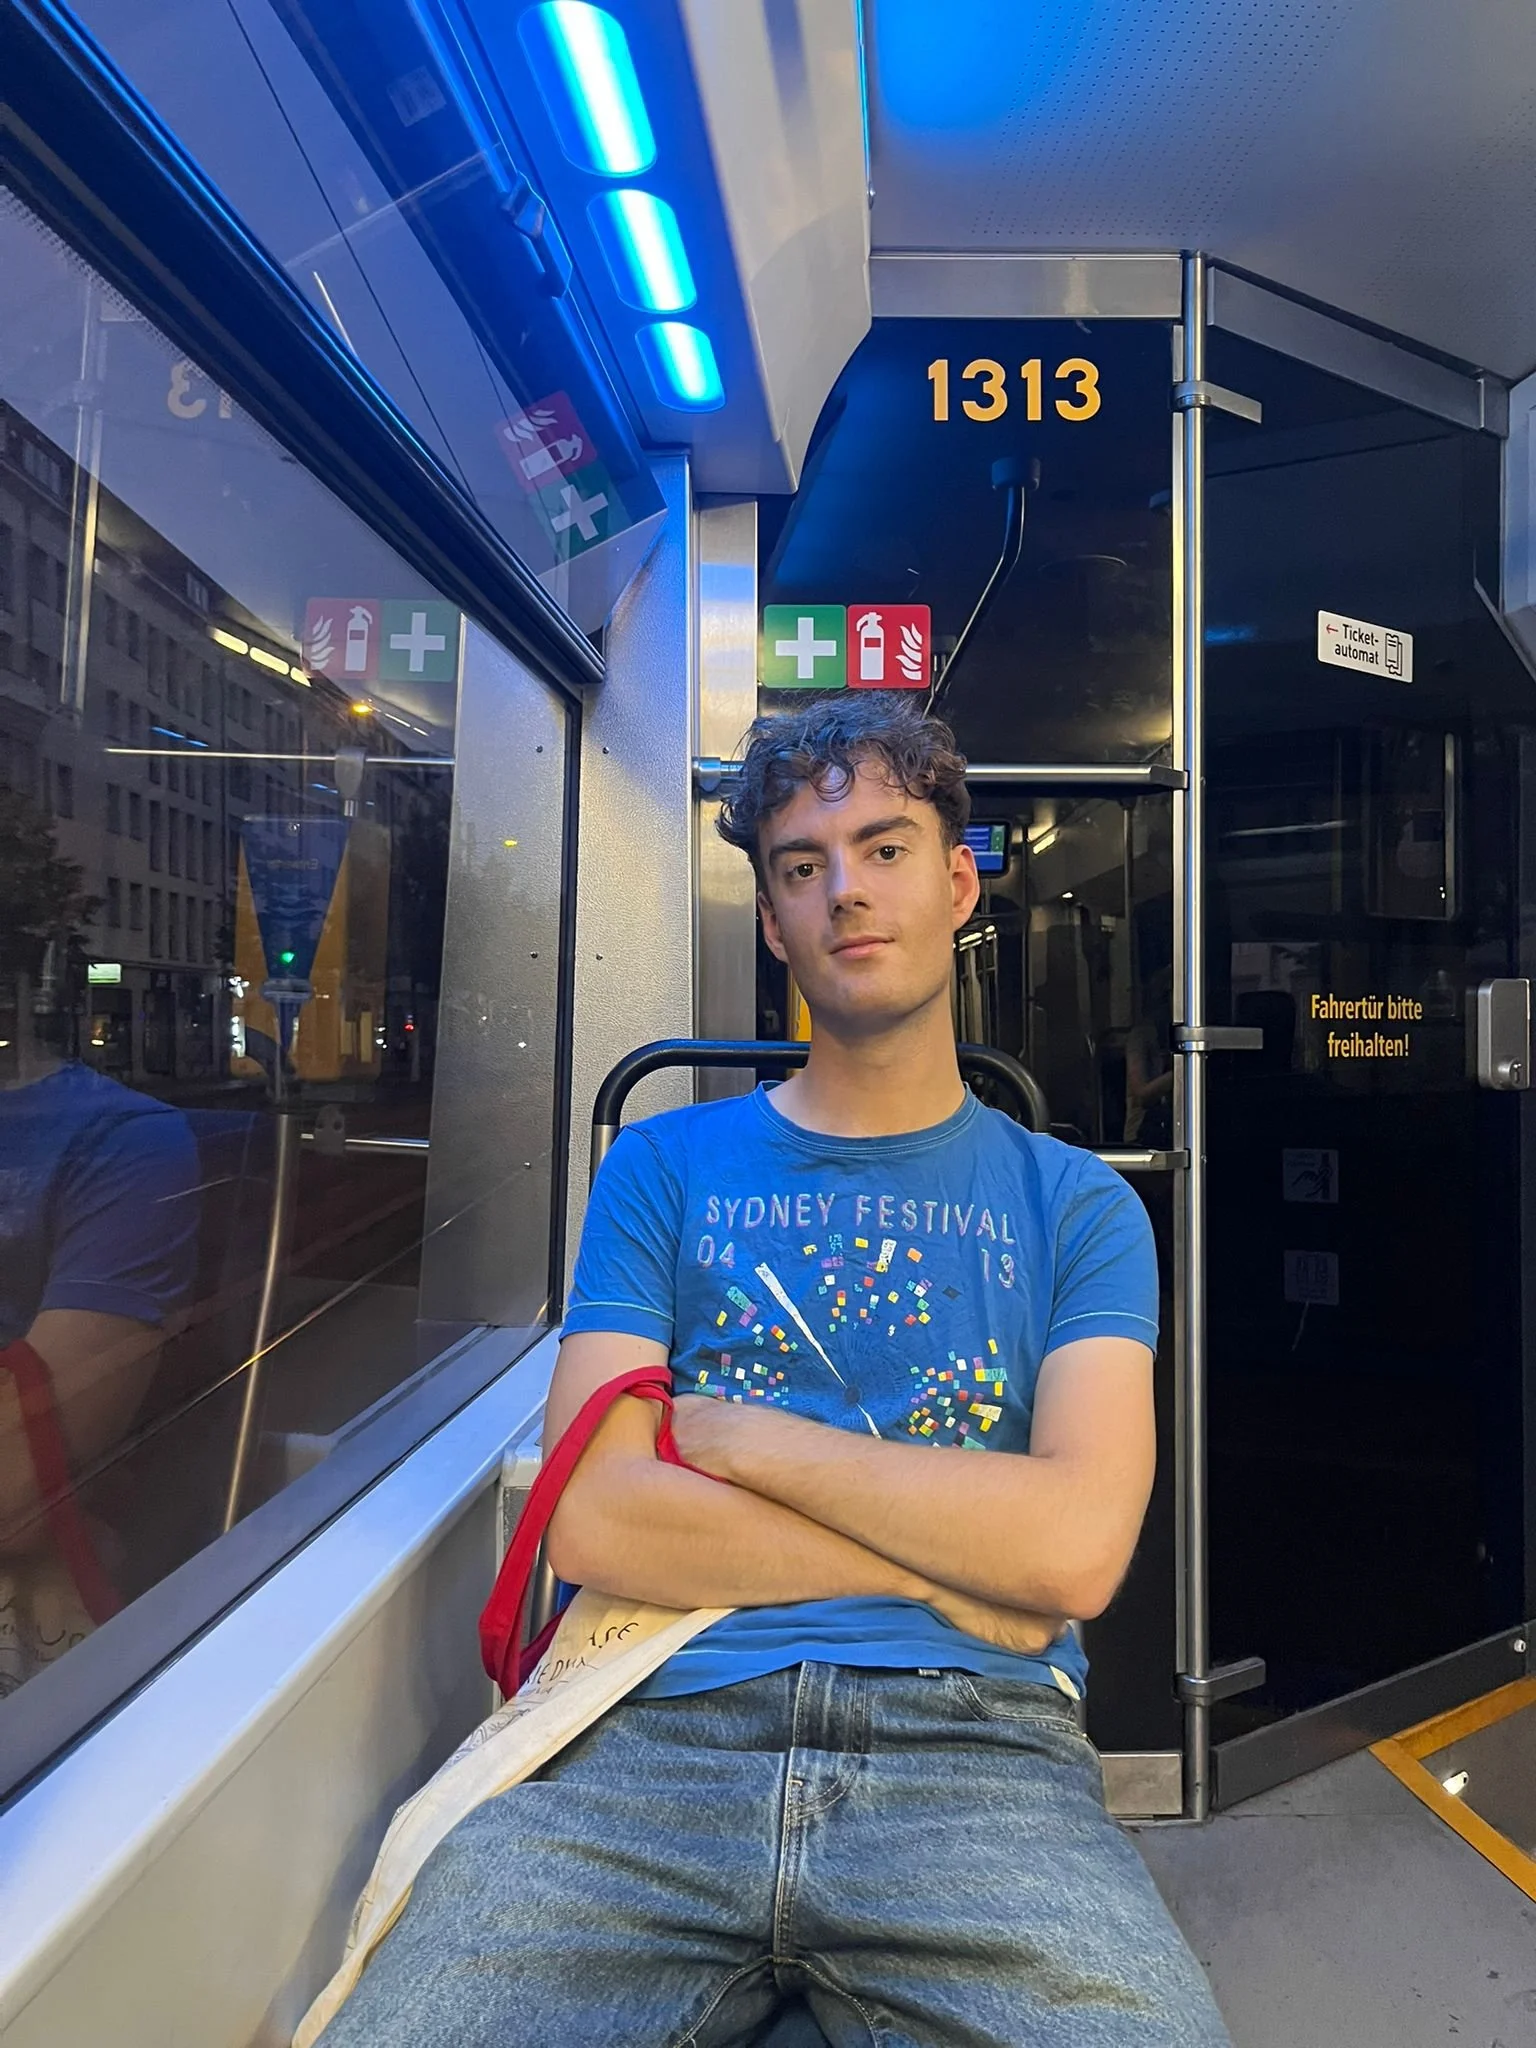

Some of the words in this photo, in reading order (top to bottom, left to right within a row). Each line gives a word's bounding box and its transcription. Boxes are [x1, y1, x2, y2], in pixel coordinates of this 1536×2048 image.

[928, 358, 1101, 421] 1313
[1342, 623, 1379, 646] Ticket-
[1334, 643, 1379, 664] automat
[1311, 993, 1383, 1019] Fahrertür
[1387, 995, 1422, 1019] bitte
[1328, 1032, 1408, 1057] freihalten!
[706, 1193, 835, 1229] SYDNEY
[856, 1194, 1016, 1245] FESTIVAL
[697, 1235, 735, 1268] 04
